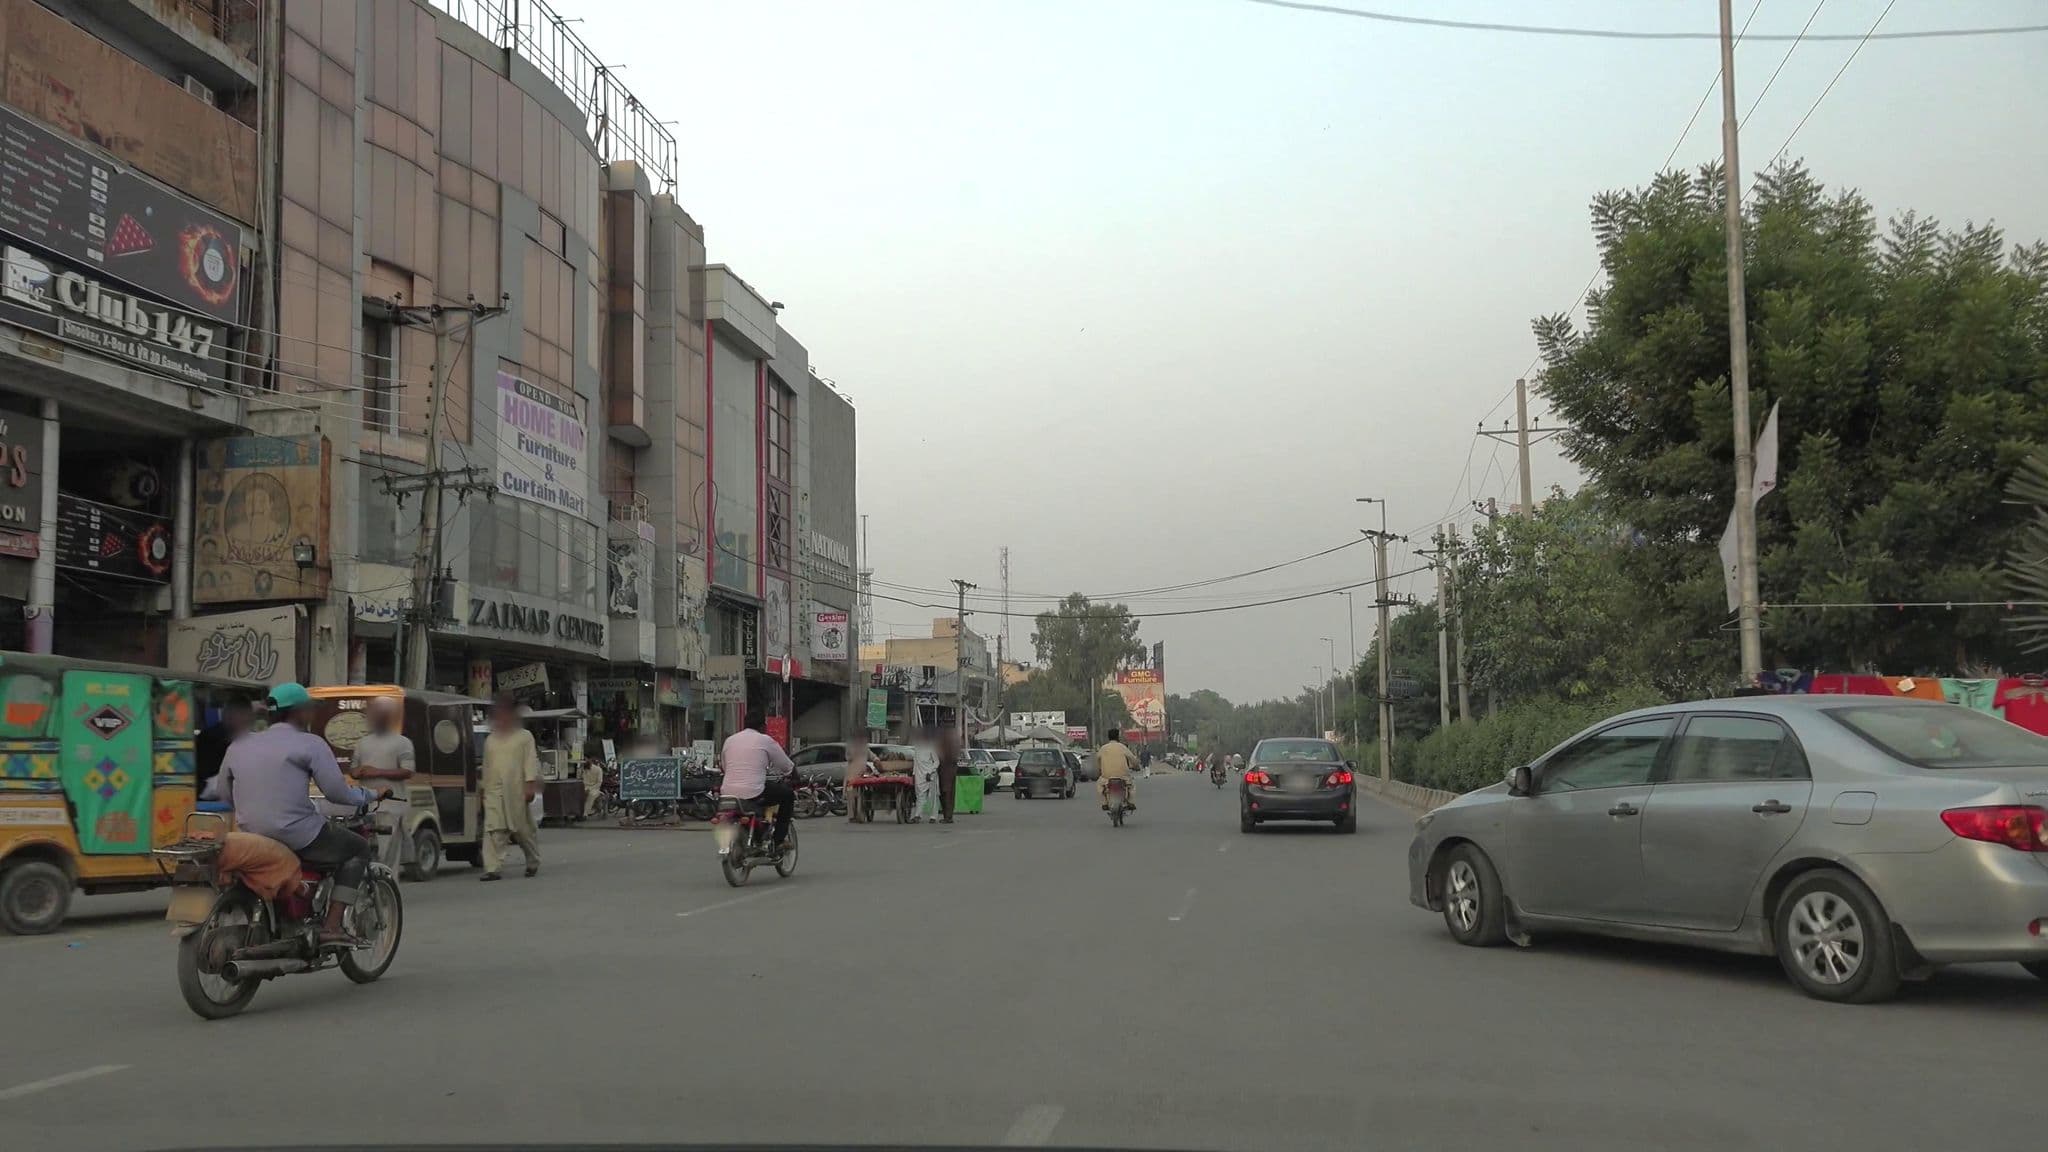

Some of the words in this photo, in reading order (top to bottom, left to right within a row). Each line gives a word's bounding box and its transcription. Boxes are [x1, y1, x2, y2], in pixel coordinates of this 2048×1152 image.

[56, 271, 149, 335] Club
[152, 312, 214, 359] 147
[519, 382, 551, 406] OPEND
[503, 393, 555, 440] HOME
[517, 431, 577, 470] Furniture
[544, 463, 554, 481] &
[502, 471, 556, 503] Curtain
[559, 488, 585, 513] Mart
[0, 503, 26, 522] ON
[810, 530, 850, 568] NATIONAL
[468, 598, 551, 636] ZAINAB
[556, 613, 605, 648] CENTRE
[1123, 676, 1158, 684] Furniture
